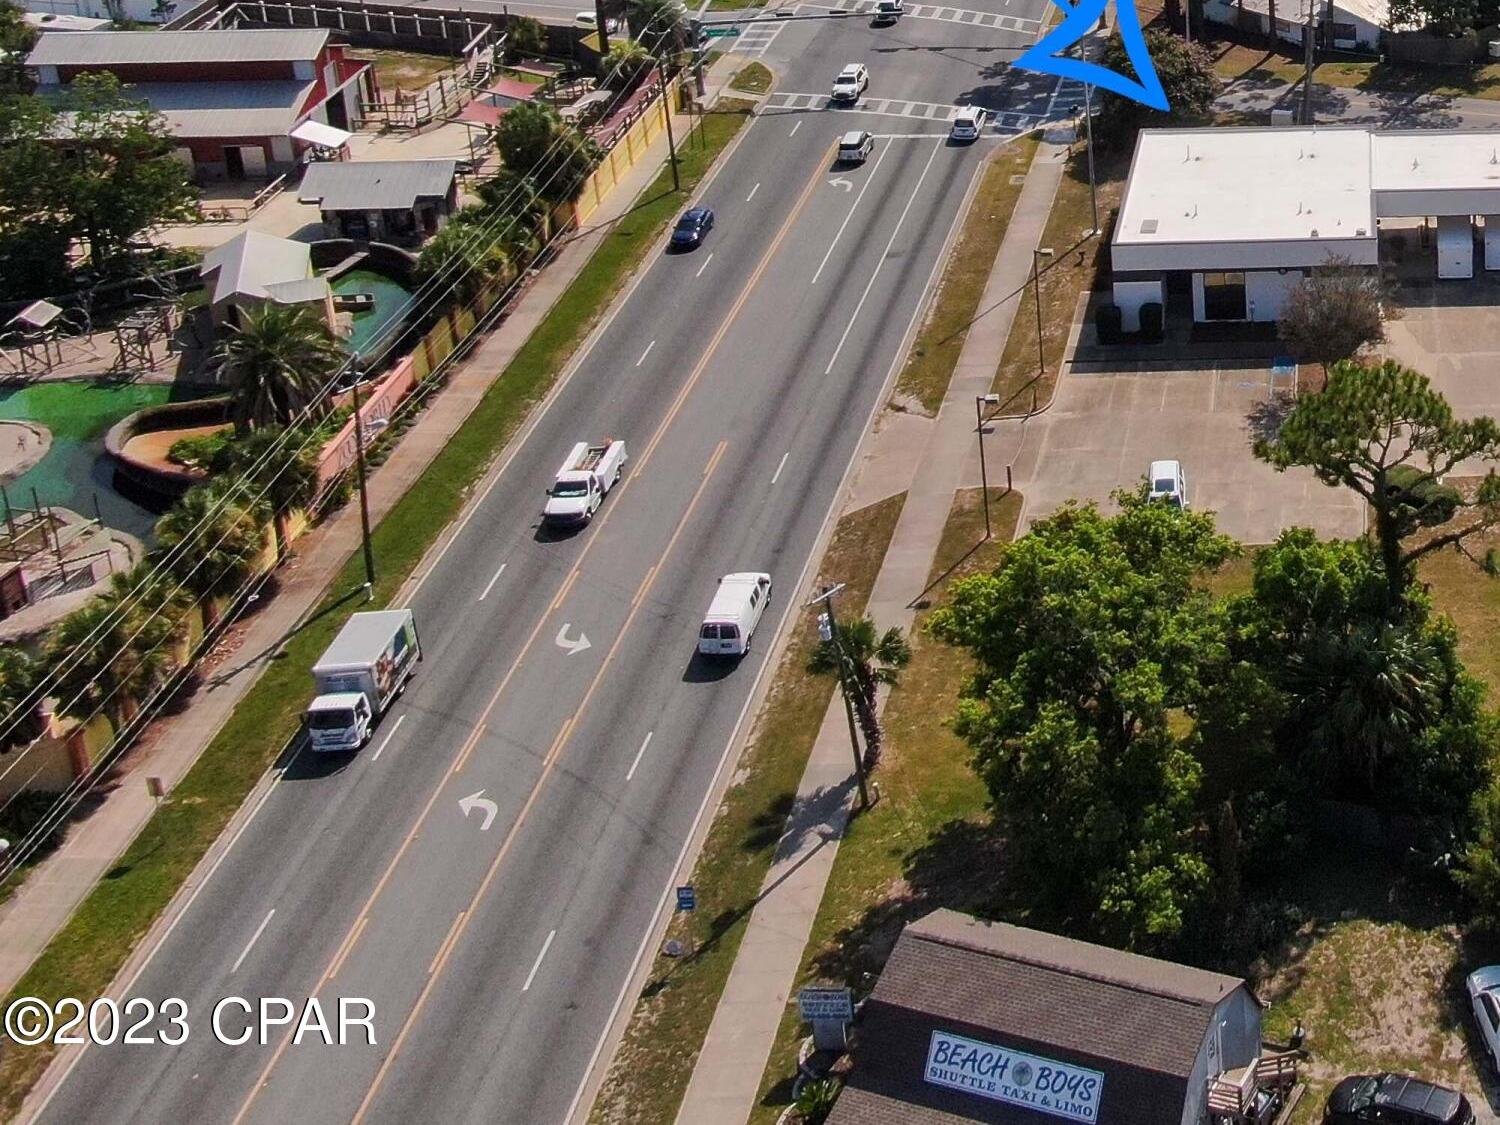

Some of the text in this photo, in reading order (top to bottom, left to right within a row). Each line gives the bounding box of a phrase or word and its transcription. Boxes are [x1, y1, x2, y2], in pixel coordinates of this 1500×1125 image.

[929, 1066, 1093, 1117] SHUTTLE TAXI & LIMO
[933, 1040, 1097, 1102] BEACH BOYS
